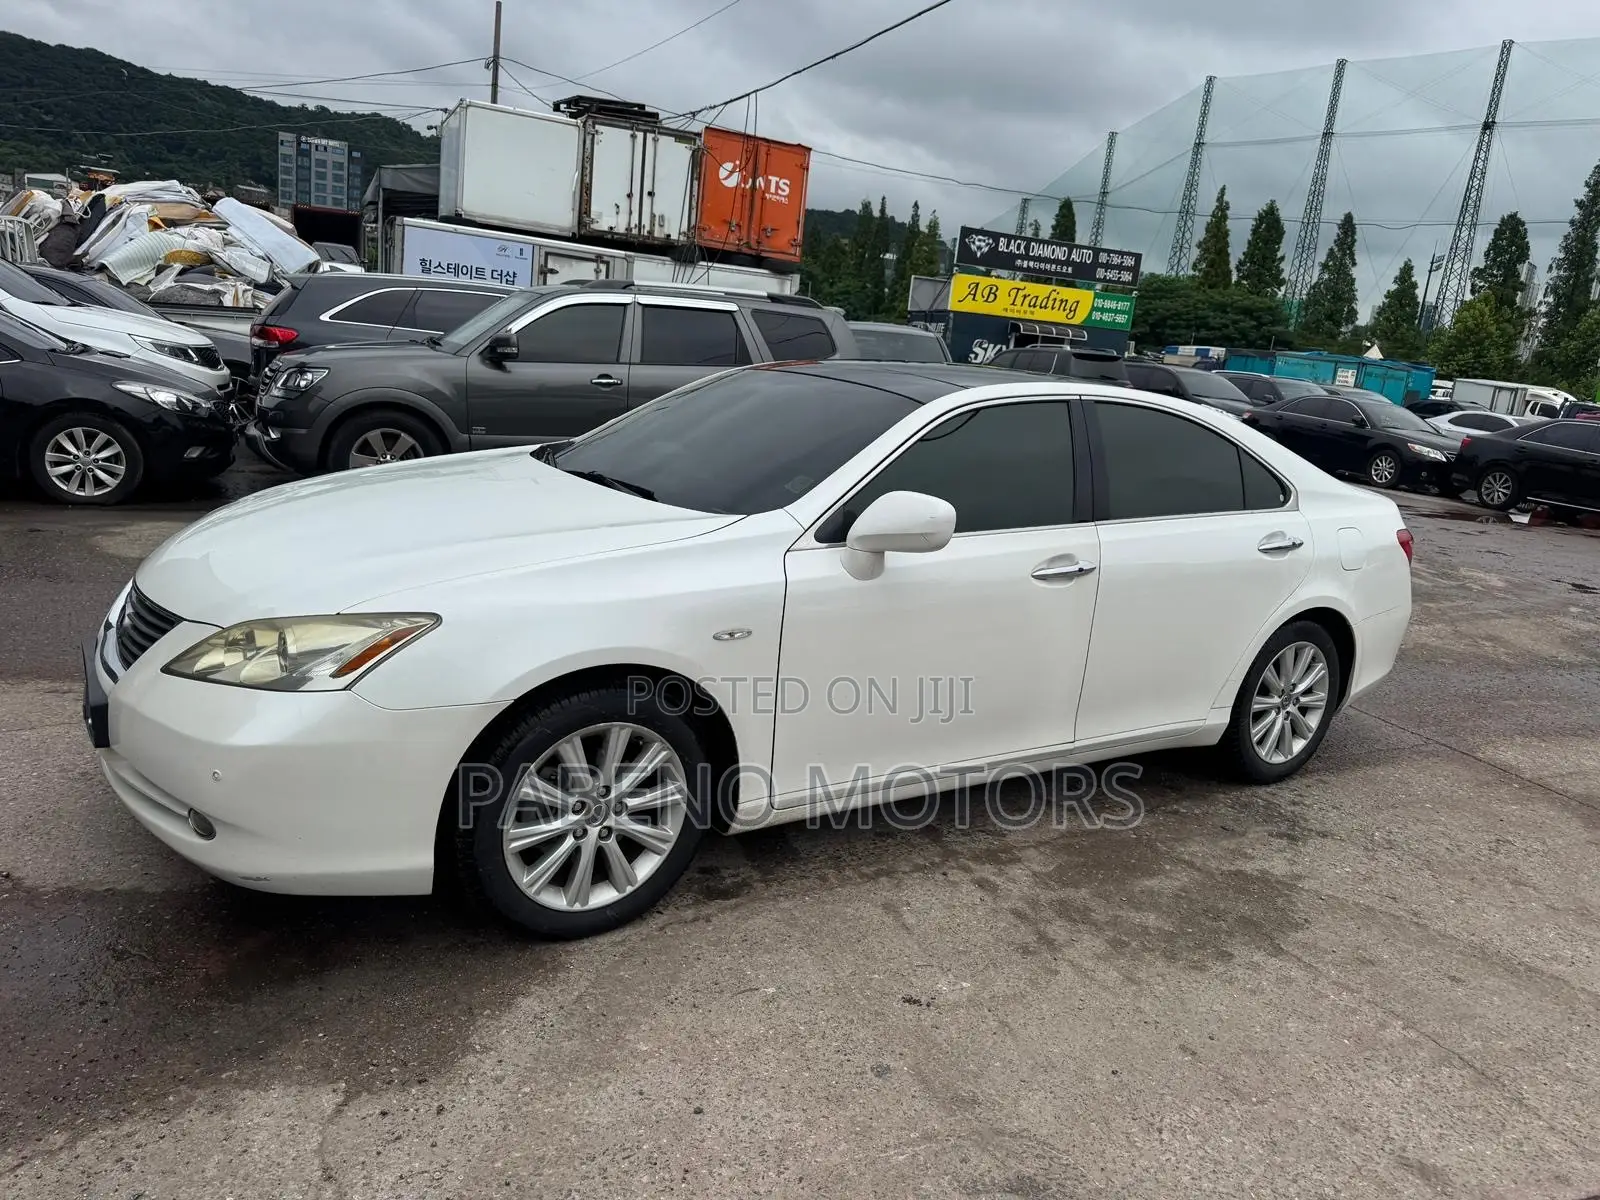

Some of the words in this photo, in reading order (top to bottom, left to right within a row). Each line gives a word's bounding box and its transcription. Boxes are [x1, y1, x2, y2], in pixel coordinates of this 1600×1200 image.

[998, 237, 1025, 255] BLACK
[1029, 241, 1068, 261] DIAMOND
[1070, 248, 1093, 264] AUTO
[419, 257, 487, 281] 힐스테이트
[490, 268, 518, 286] 더샵
[957, 282, 999, 303] AB
[1007, 285, 1080, 320] Trading
